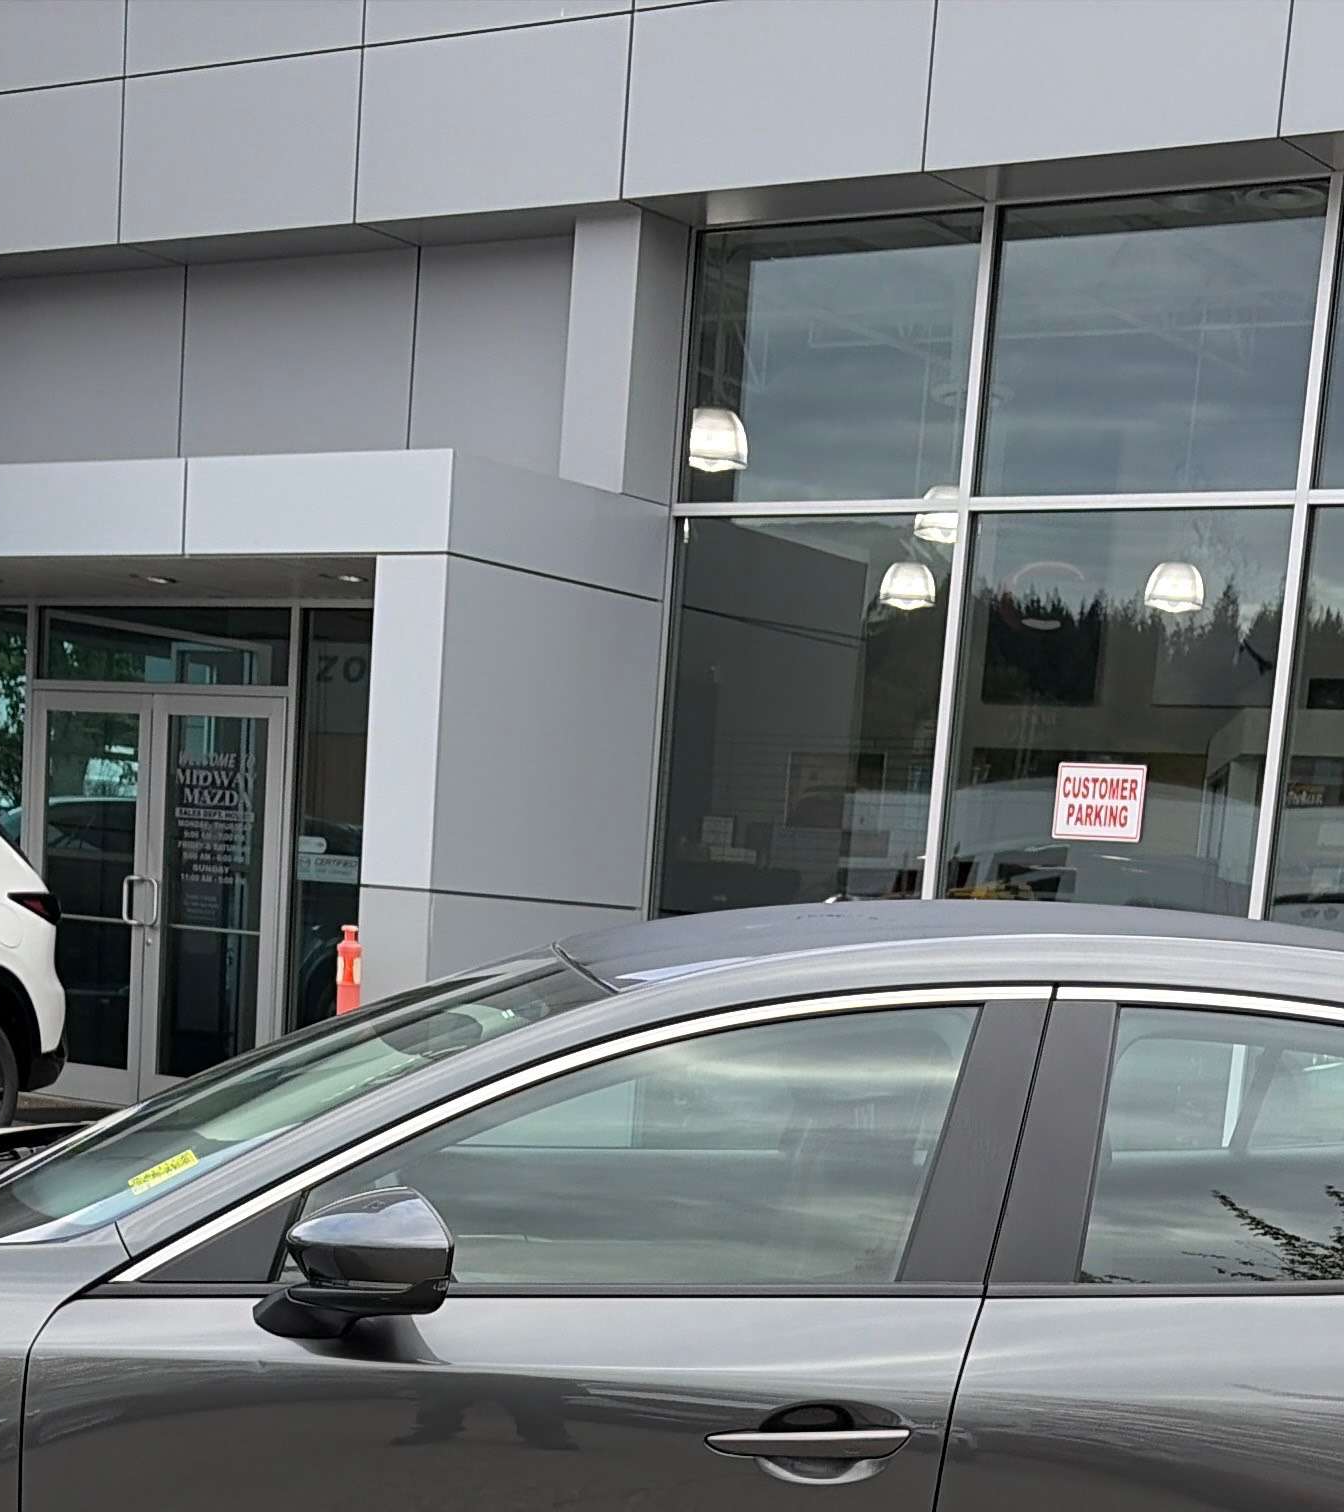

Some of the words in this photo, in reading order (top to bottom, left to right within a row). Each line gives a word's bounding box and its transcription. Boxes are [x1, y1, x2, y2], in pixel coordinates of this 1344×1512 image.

[176, 768, 256, 789] MIDWAY
[1063, 776, 1138, 801] CUSTOMER
[183, 787, 253, 812] MAZDA
[1066, 803, 1128, 828] PARKING
